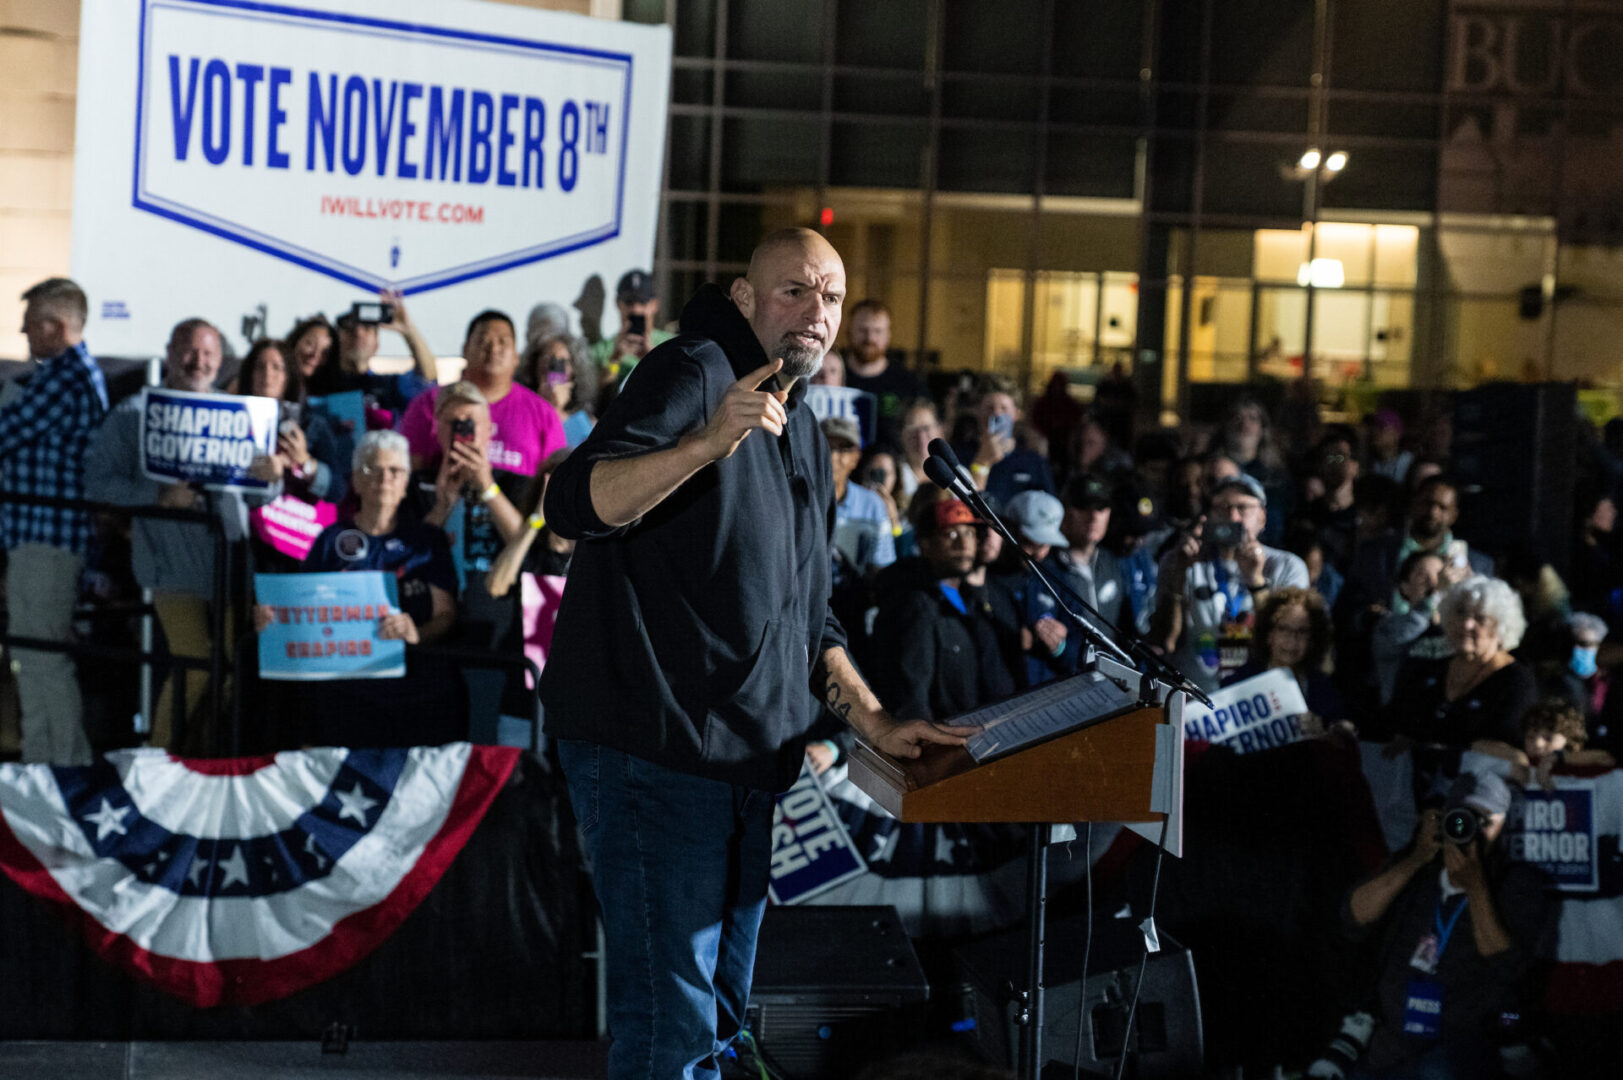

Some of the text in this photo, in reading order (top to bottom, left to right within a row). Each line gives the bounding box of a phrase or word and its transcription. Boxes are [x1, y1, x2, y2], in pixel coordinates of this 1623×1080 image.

[168, 54, 609, 193] VOTE NOVEMBER 8TH
[320, 194, 485, 223] IWILLVOTE.COM
[148, 403, 248, 439] SHAPIRO
[811, 389, 860, 424] OTE
[147, 431, 253, 470] GOVERNO
[1185, 693, 1270, 739] HAPIRO
[770, 803, 811, 880] SH
[1407, 997, 1441, 1014] PRESS
